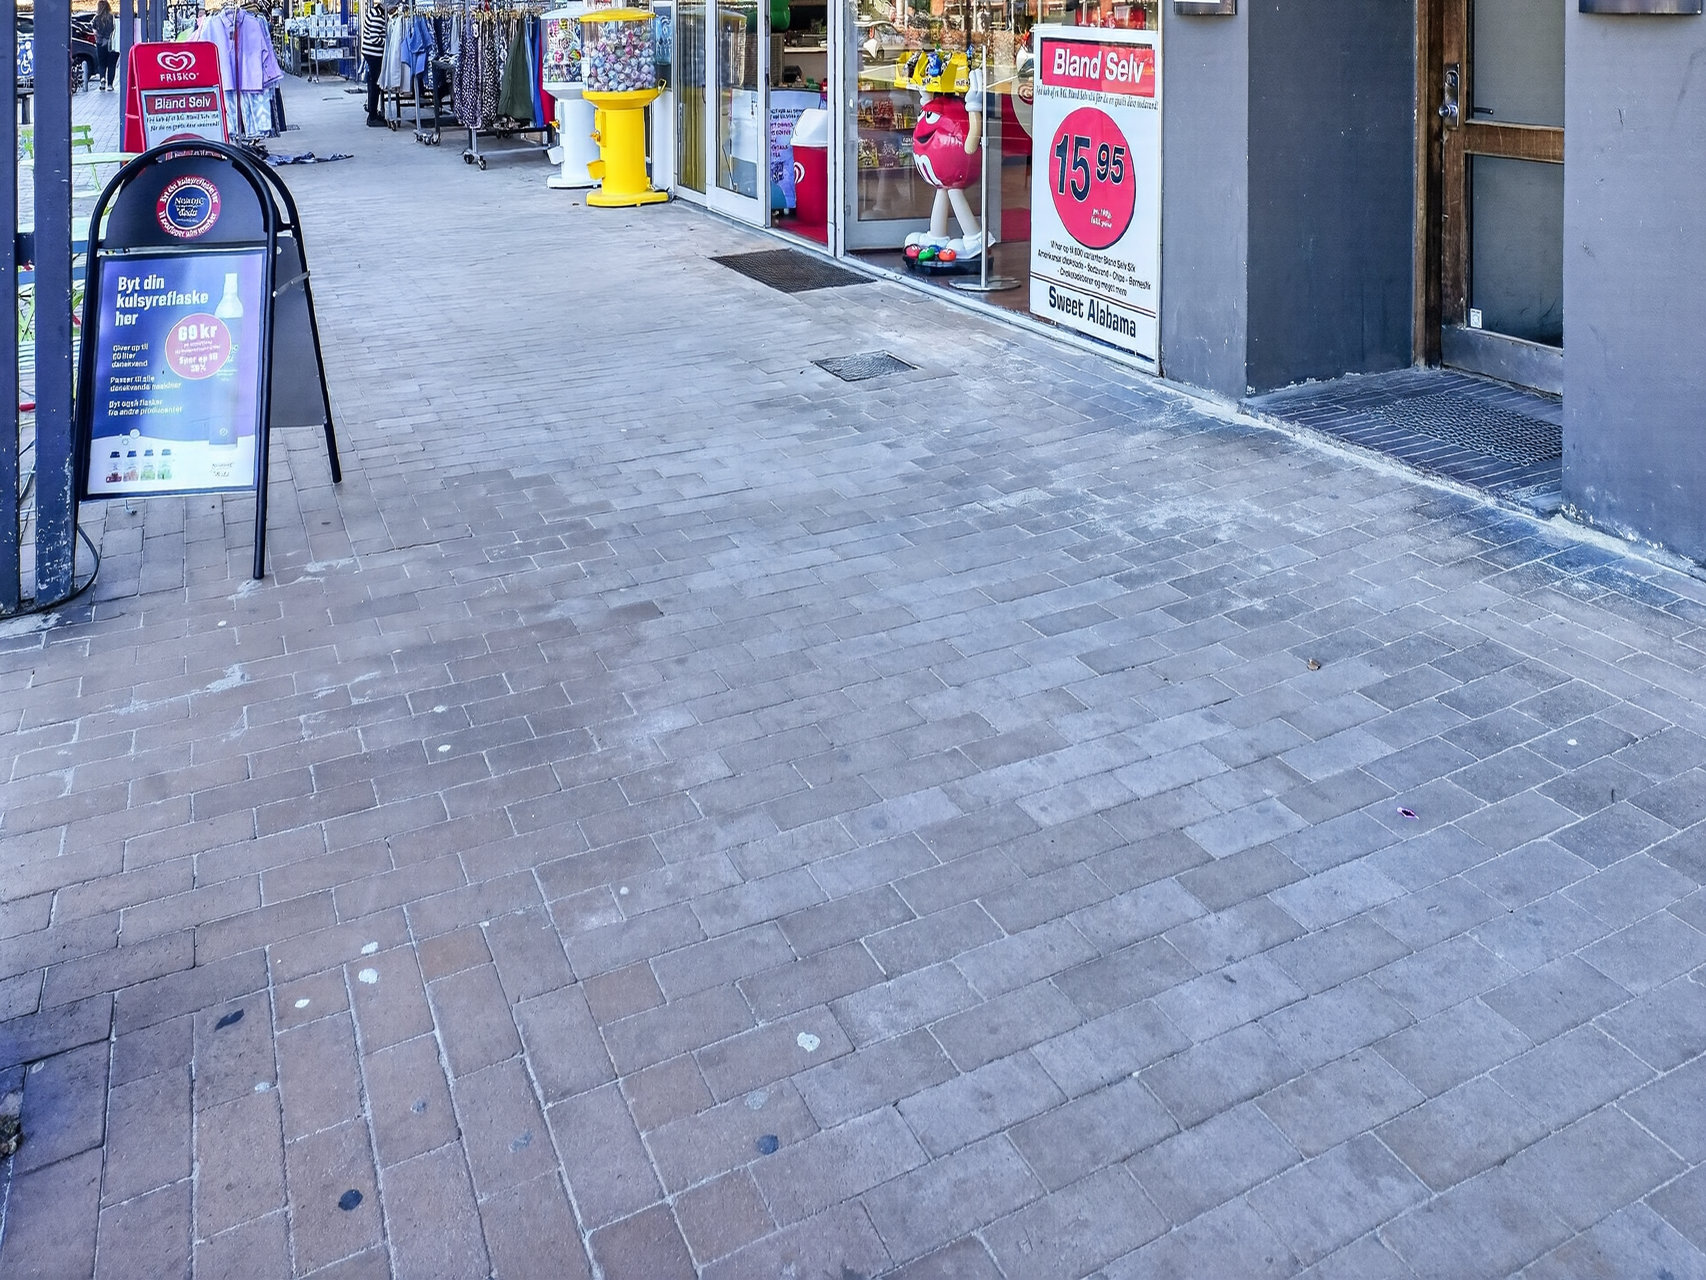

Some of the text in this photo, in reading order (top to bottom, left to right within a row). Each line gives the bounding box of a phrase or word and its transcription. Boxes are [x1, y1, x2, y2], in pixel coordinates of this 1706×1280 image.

[1053, 48, 1144, 84] Bland Selv
[160, 72, 197, 82] FRISKO
[155, 97, 186, 110] Bland
[1055, 134, 1125, 202] 15 95
[118, 274, 165, 294] Byt din
[116, 289, 209, 311] kulsyreflaske
[115, 311, 139, 326] her
[1048, 285, 1136, 338] Sweet Alabama
[200, 323, 218, 339] kr
